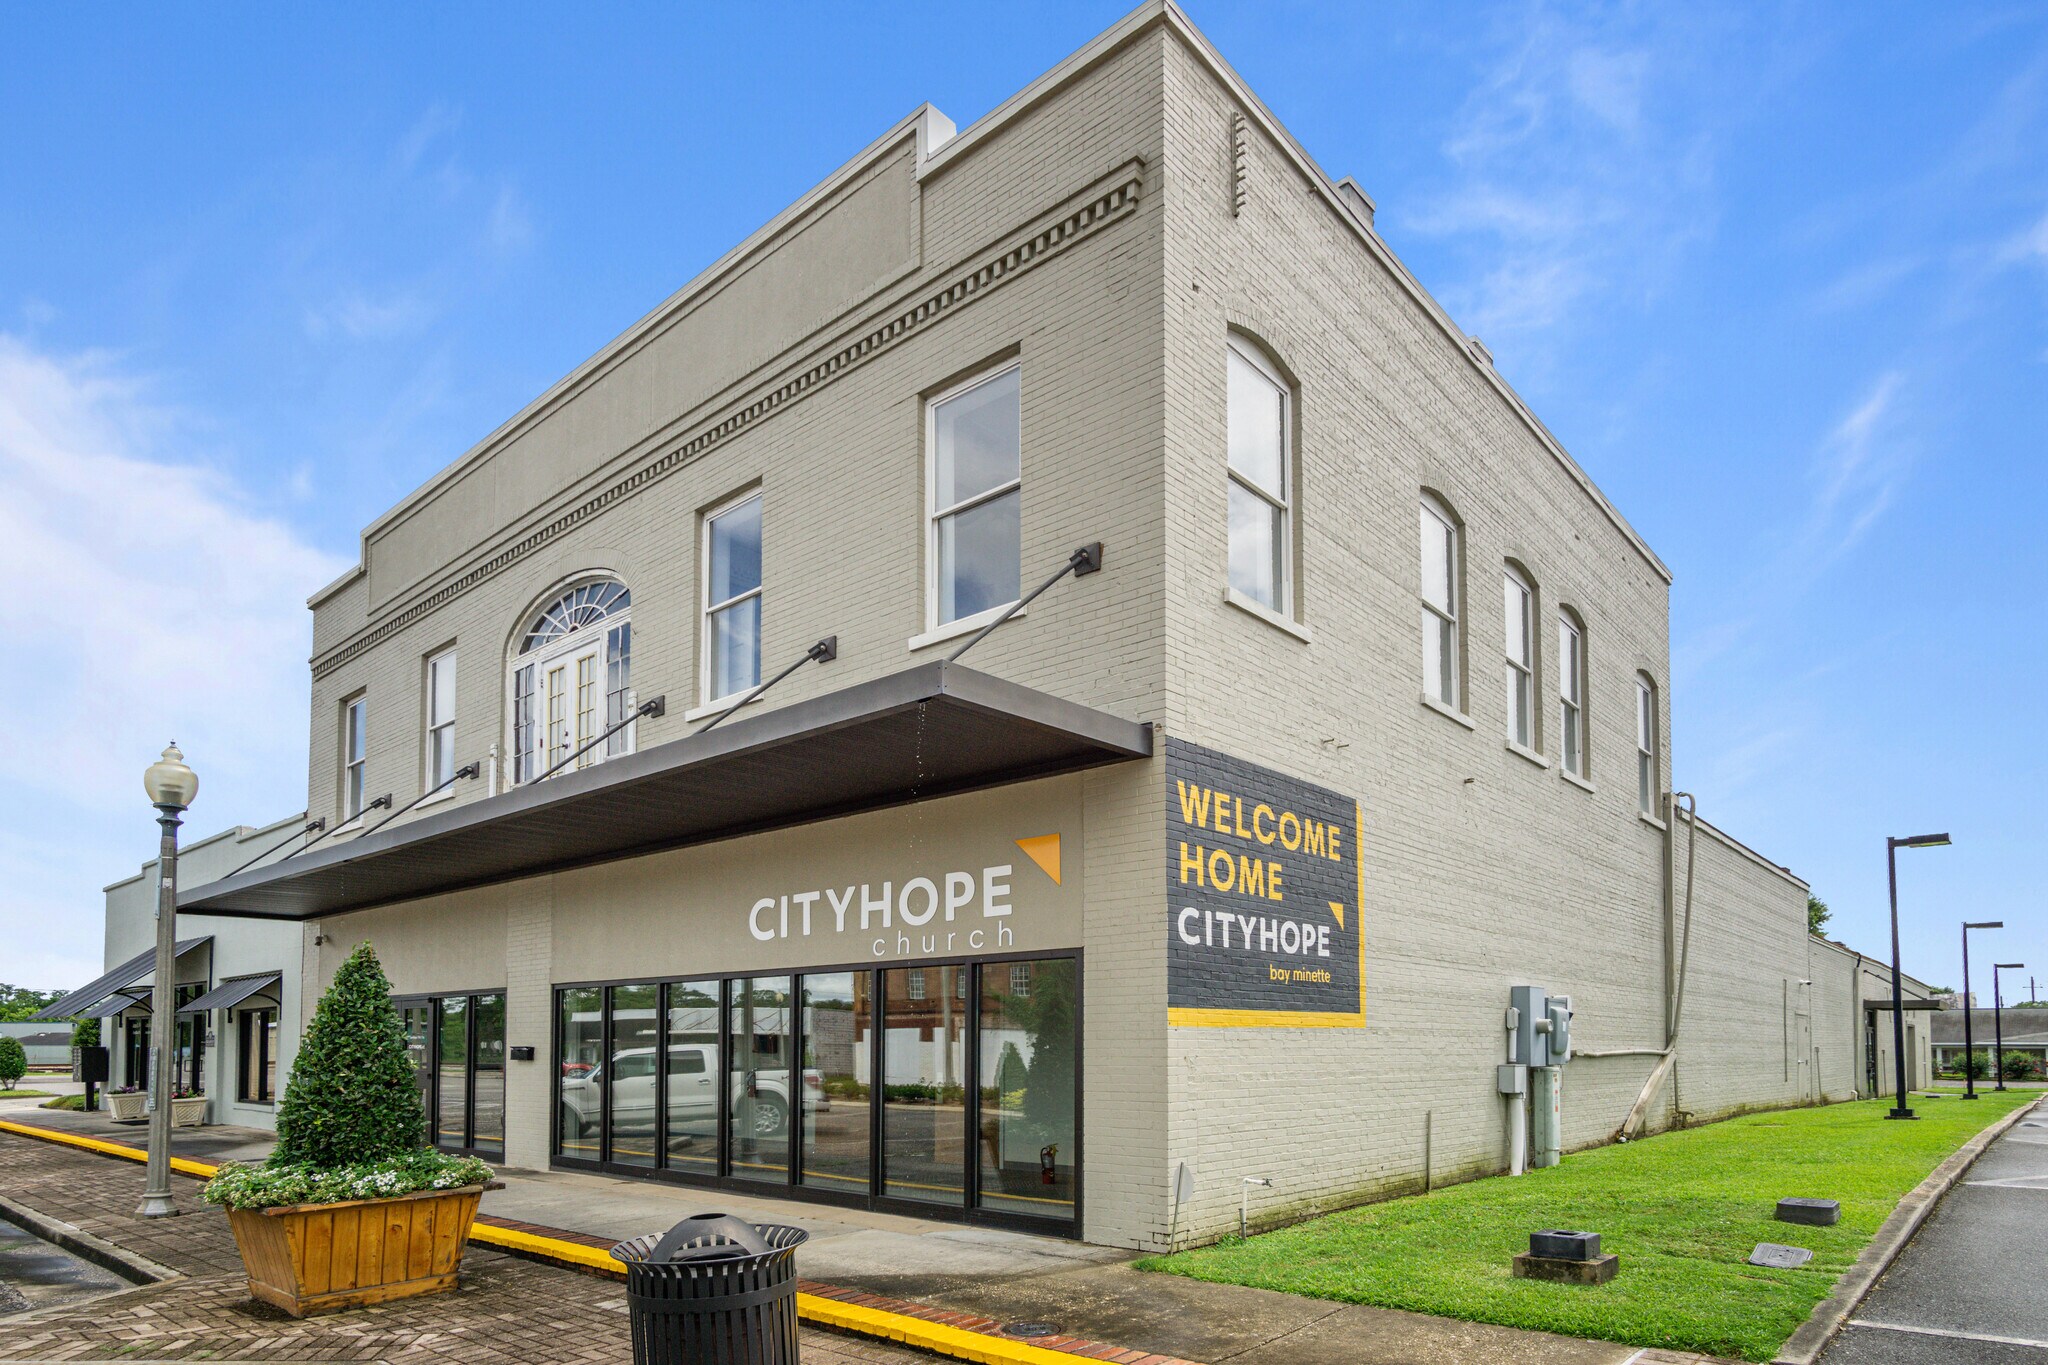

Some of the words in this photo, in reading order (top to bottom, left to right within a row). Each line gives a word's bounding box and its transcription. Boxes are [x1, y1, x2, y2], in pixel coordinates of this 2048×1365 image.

[1177, 779, 1341, 861] WELCOME
[1180, 842, 1283, 901] HOME
[749, 864, 1013, 941] CITYHOPE
[873, 920, 1014, 956] church
[1177, 907, 1330, 957] CITYHOPE
[1269, 963, 1291, 985] bay
[1293, 966, 1331, 983] minette
